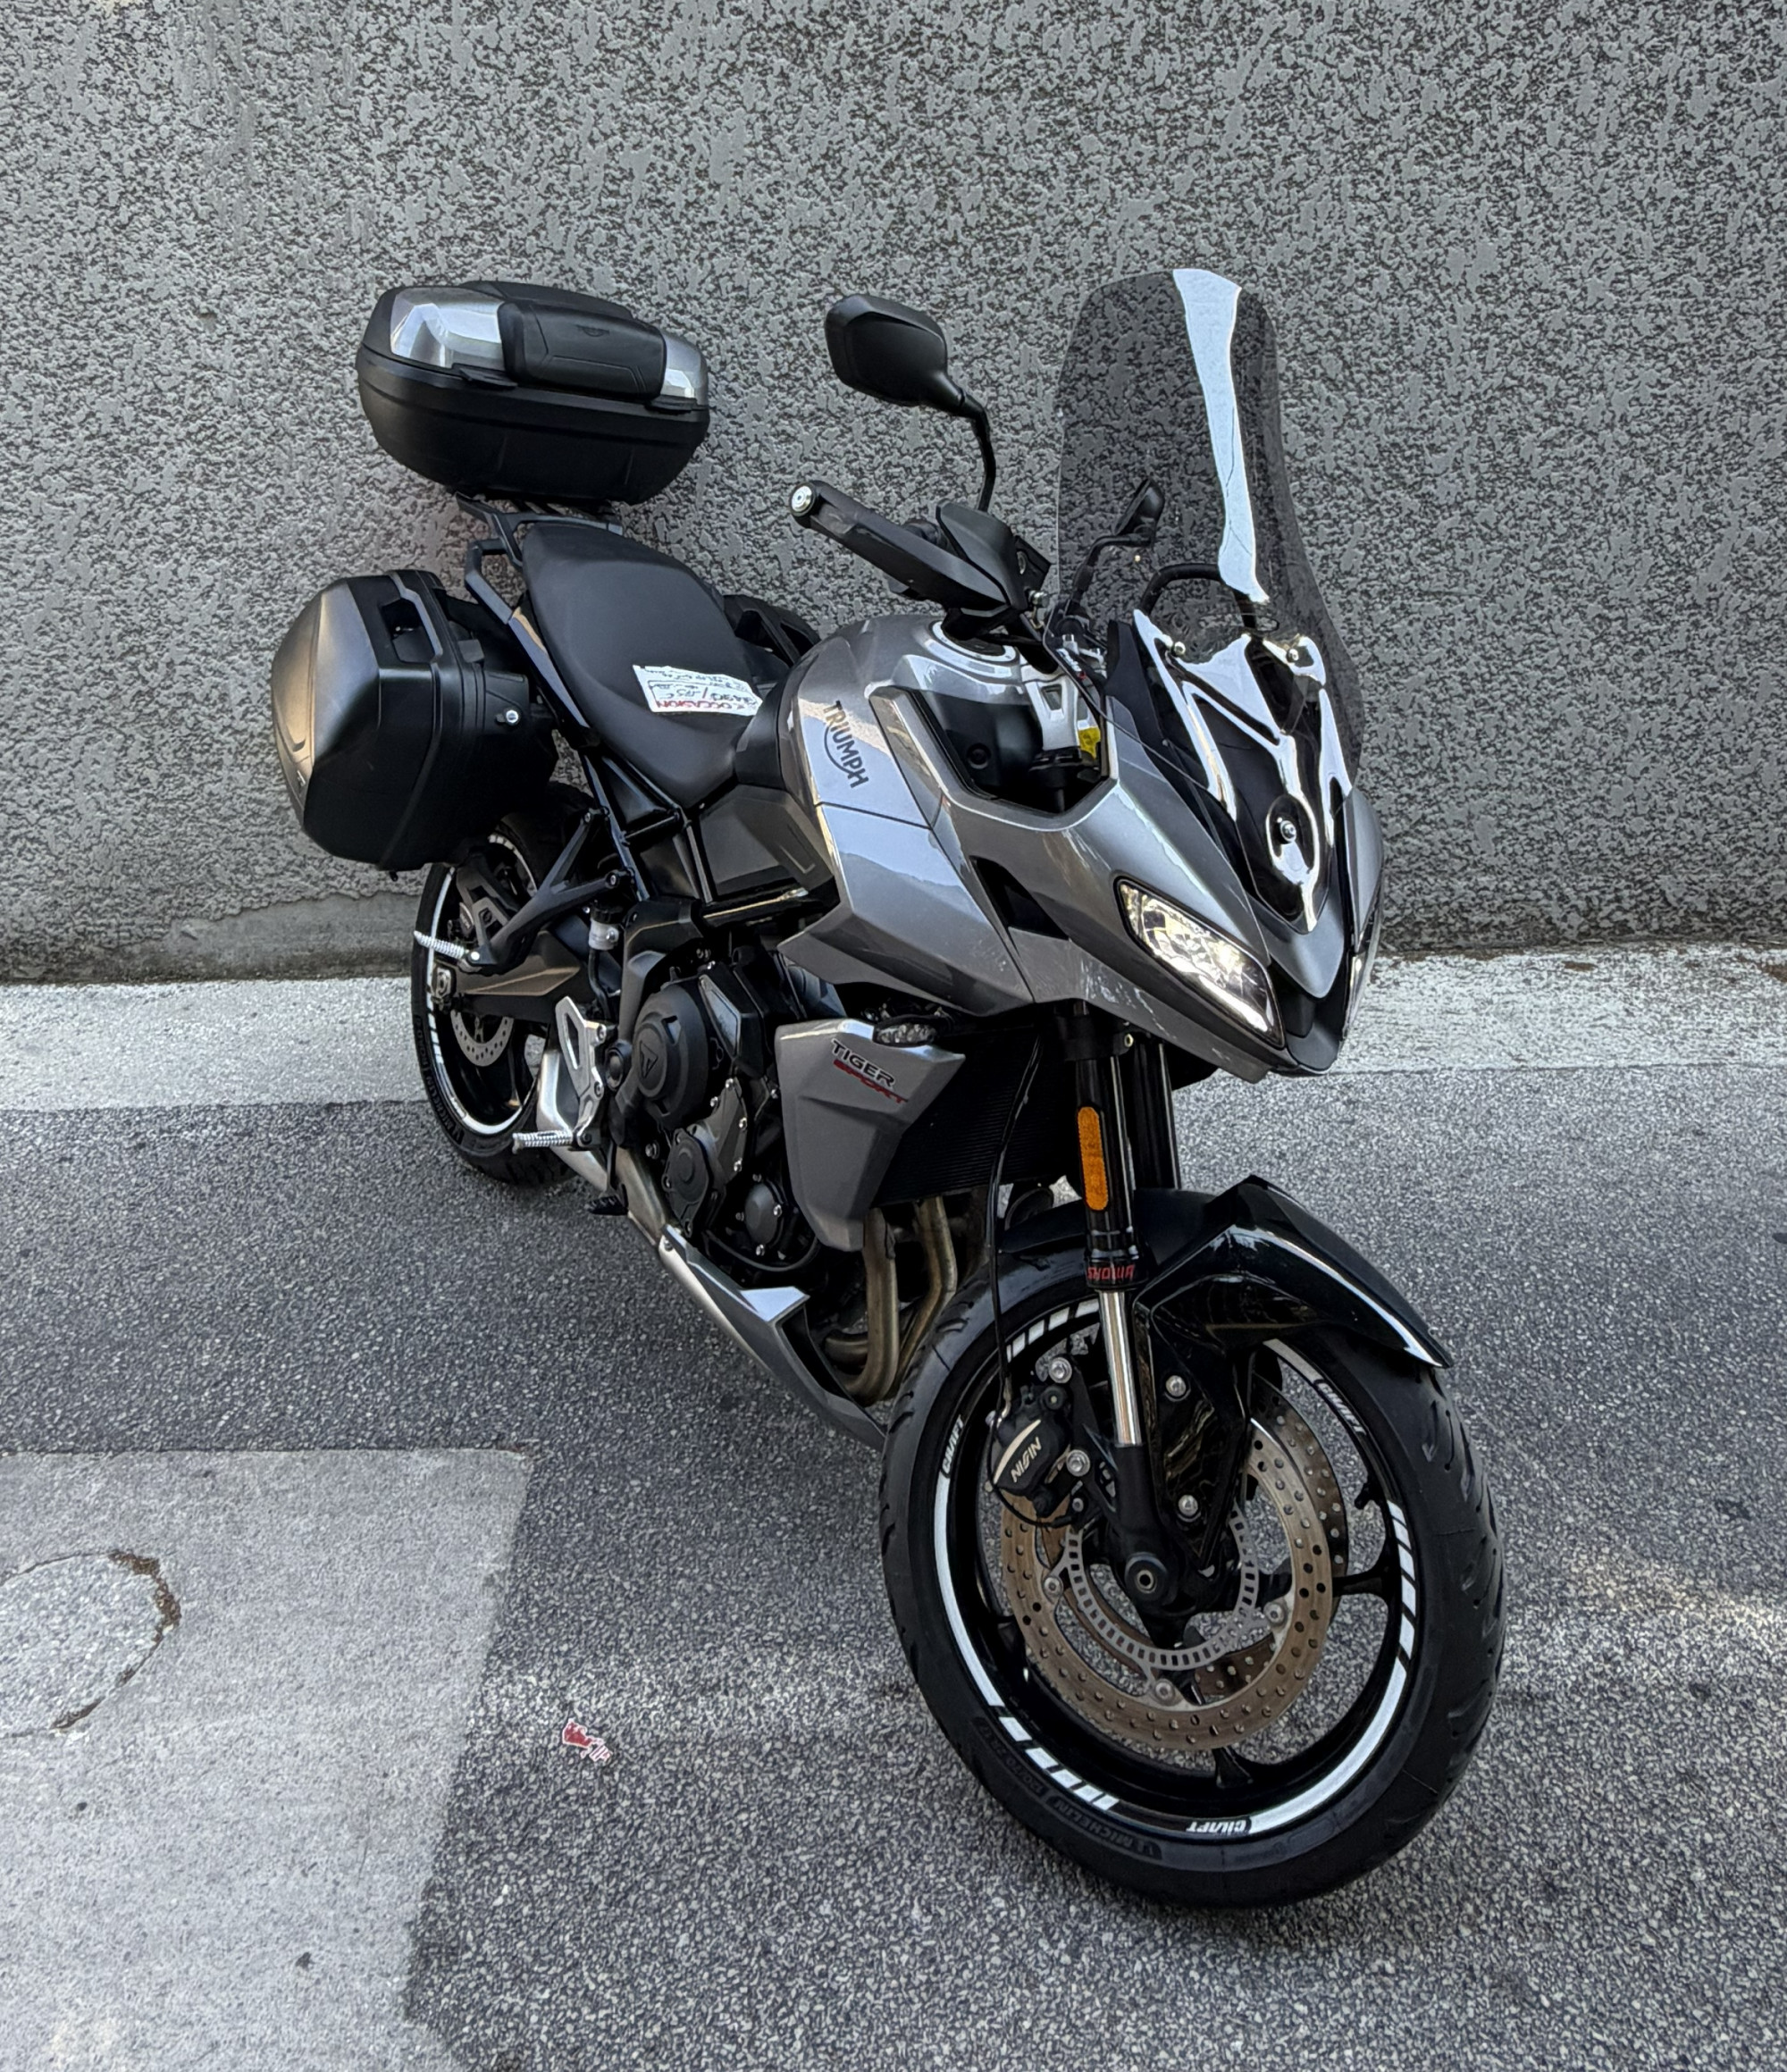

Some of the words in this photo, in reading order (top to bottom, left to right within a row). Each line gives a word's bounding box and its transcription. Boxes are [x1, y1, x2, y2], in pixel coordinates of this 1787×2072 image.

[823, 700, 869, 788] TRIUMPH
[831, 1038, 895, 1087] TIGER
[1086, 1263, 1136, 1282] SHOWA
[1053, 1799, 1133, 1849] MICHELIN
